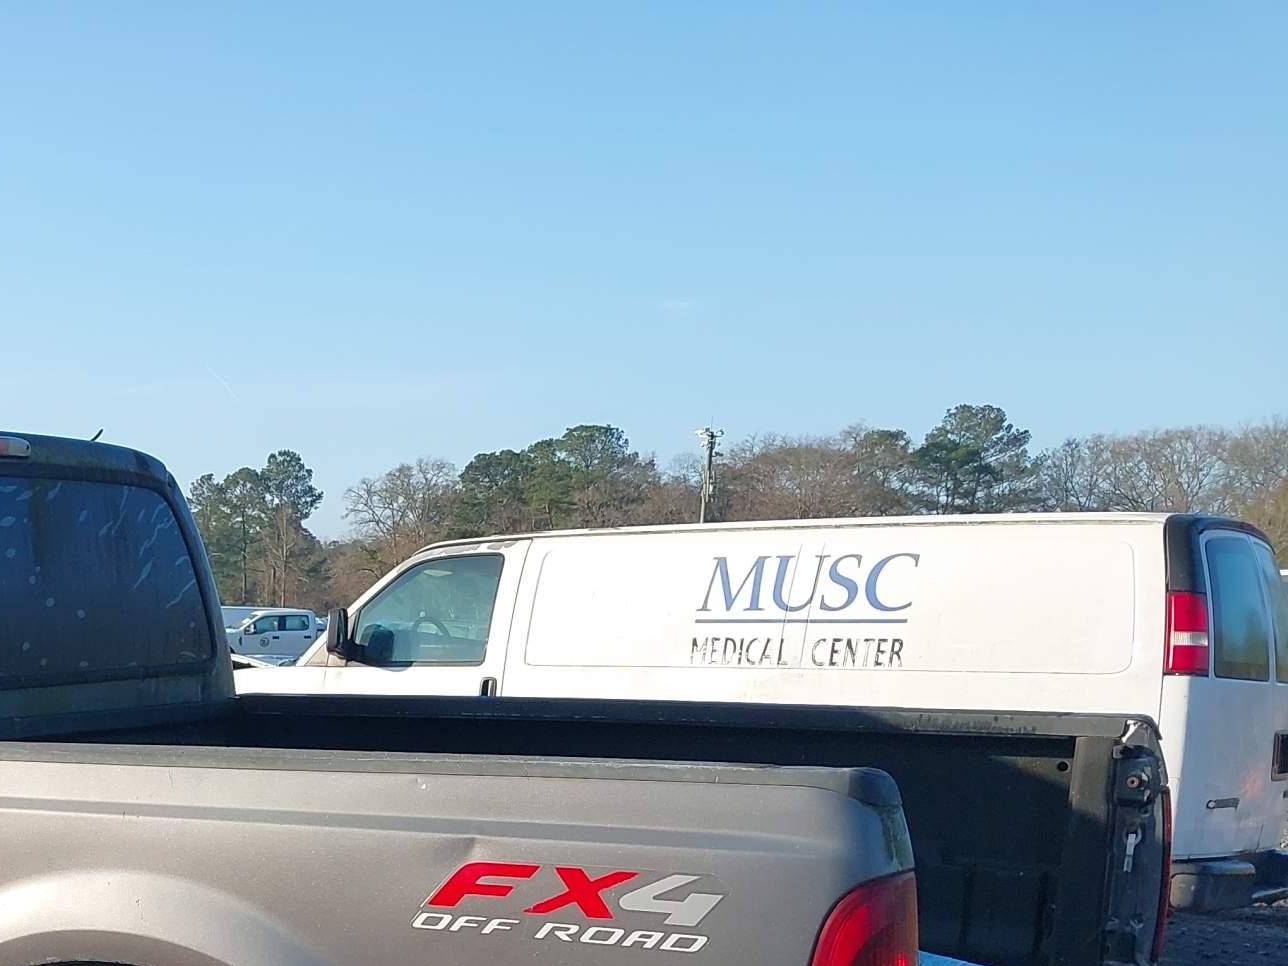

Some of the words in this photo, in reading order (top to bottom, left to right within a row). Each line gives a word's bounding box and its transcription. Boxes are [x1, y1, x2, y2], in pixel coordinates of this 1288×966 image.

[696, 553, 920, 612] MUSC
[690, 637, 789, 666] MEDICAL
[811, 637, 904, 667] CENTER
[427, 861, 724, 927] FX4
[412, 912, 520, 934] OFF
[534, 922, 708, 952] ROAD
